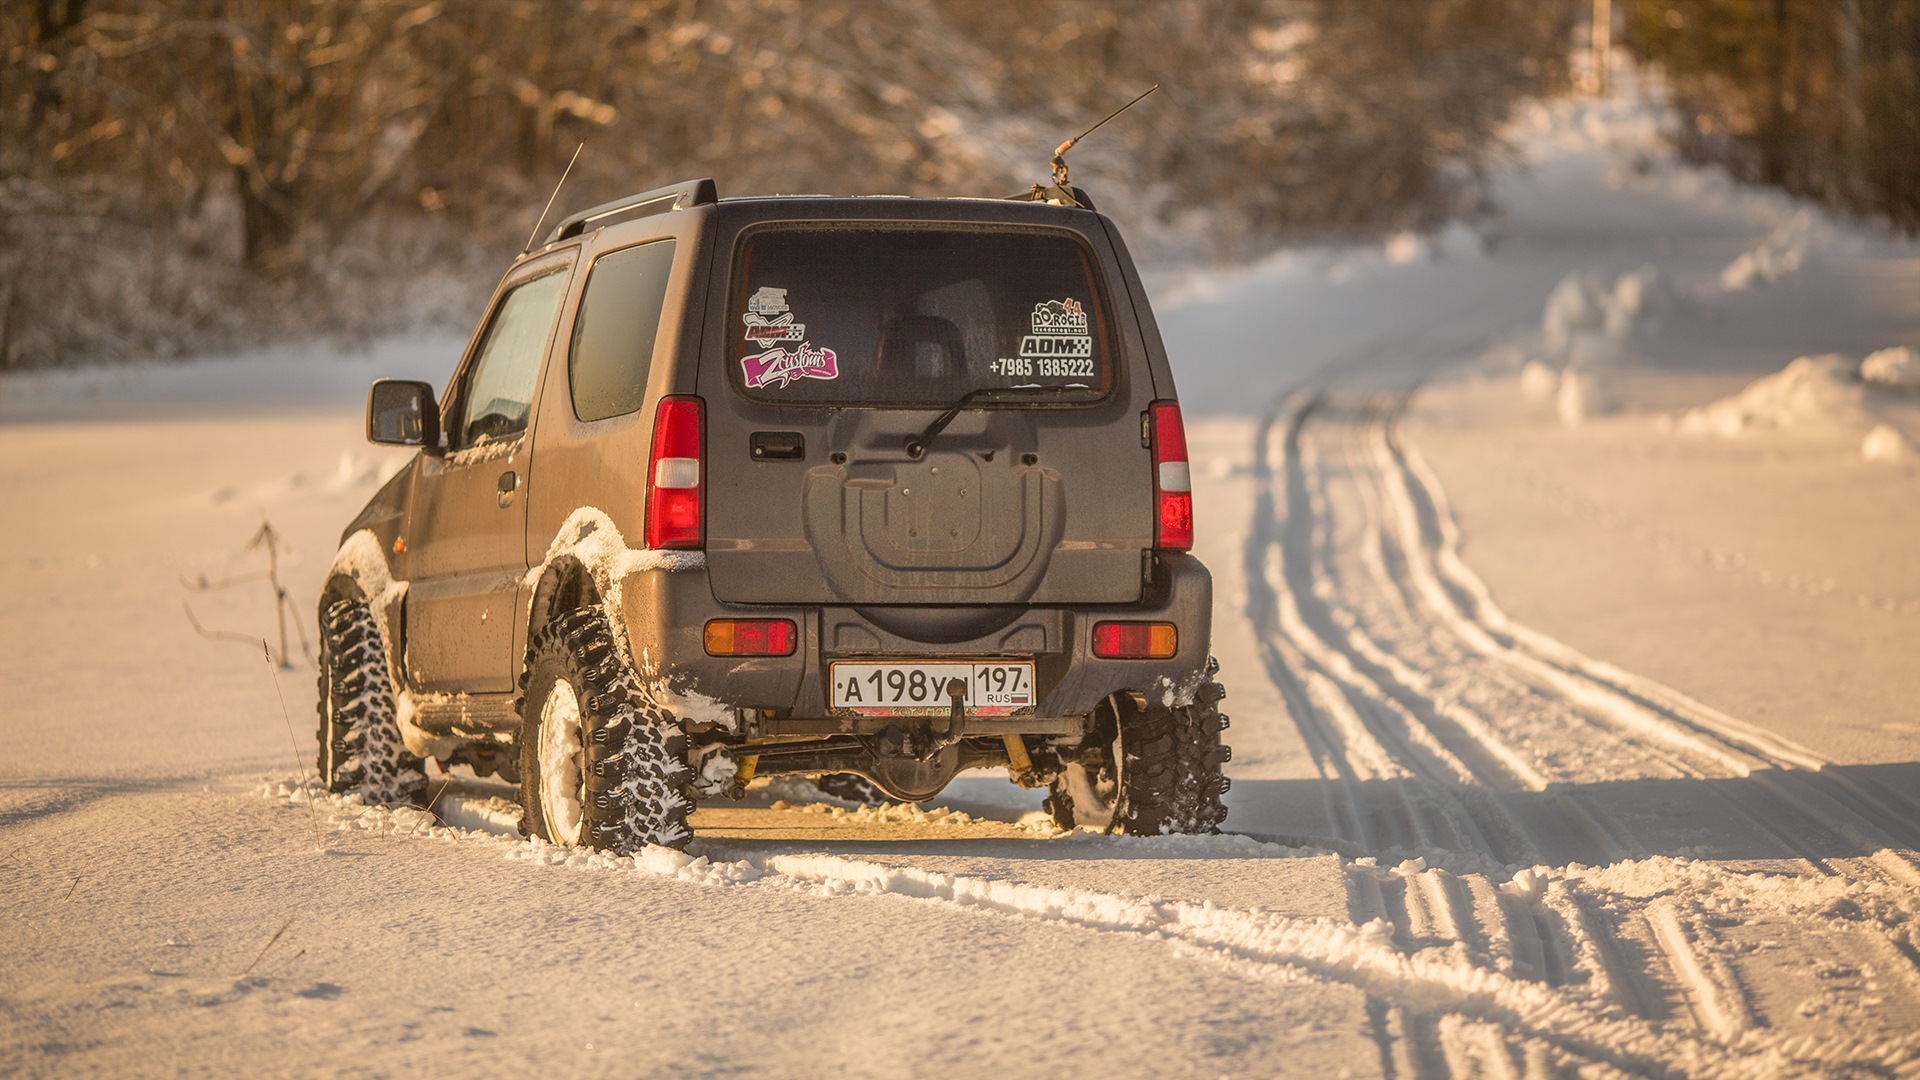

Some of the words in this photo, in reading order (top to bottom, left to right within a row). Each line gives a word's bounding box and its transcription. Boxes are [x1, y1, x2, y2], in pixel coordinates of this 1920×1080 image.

[1022, 339, 1075, 354] ADM
[990, 359, 1032, 376] +7985
[1037, 359, 1094, 376] 1385222
[977, 667, 1022, 692] 197
[987, 694, 1010, 703] RUS
